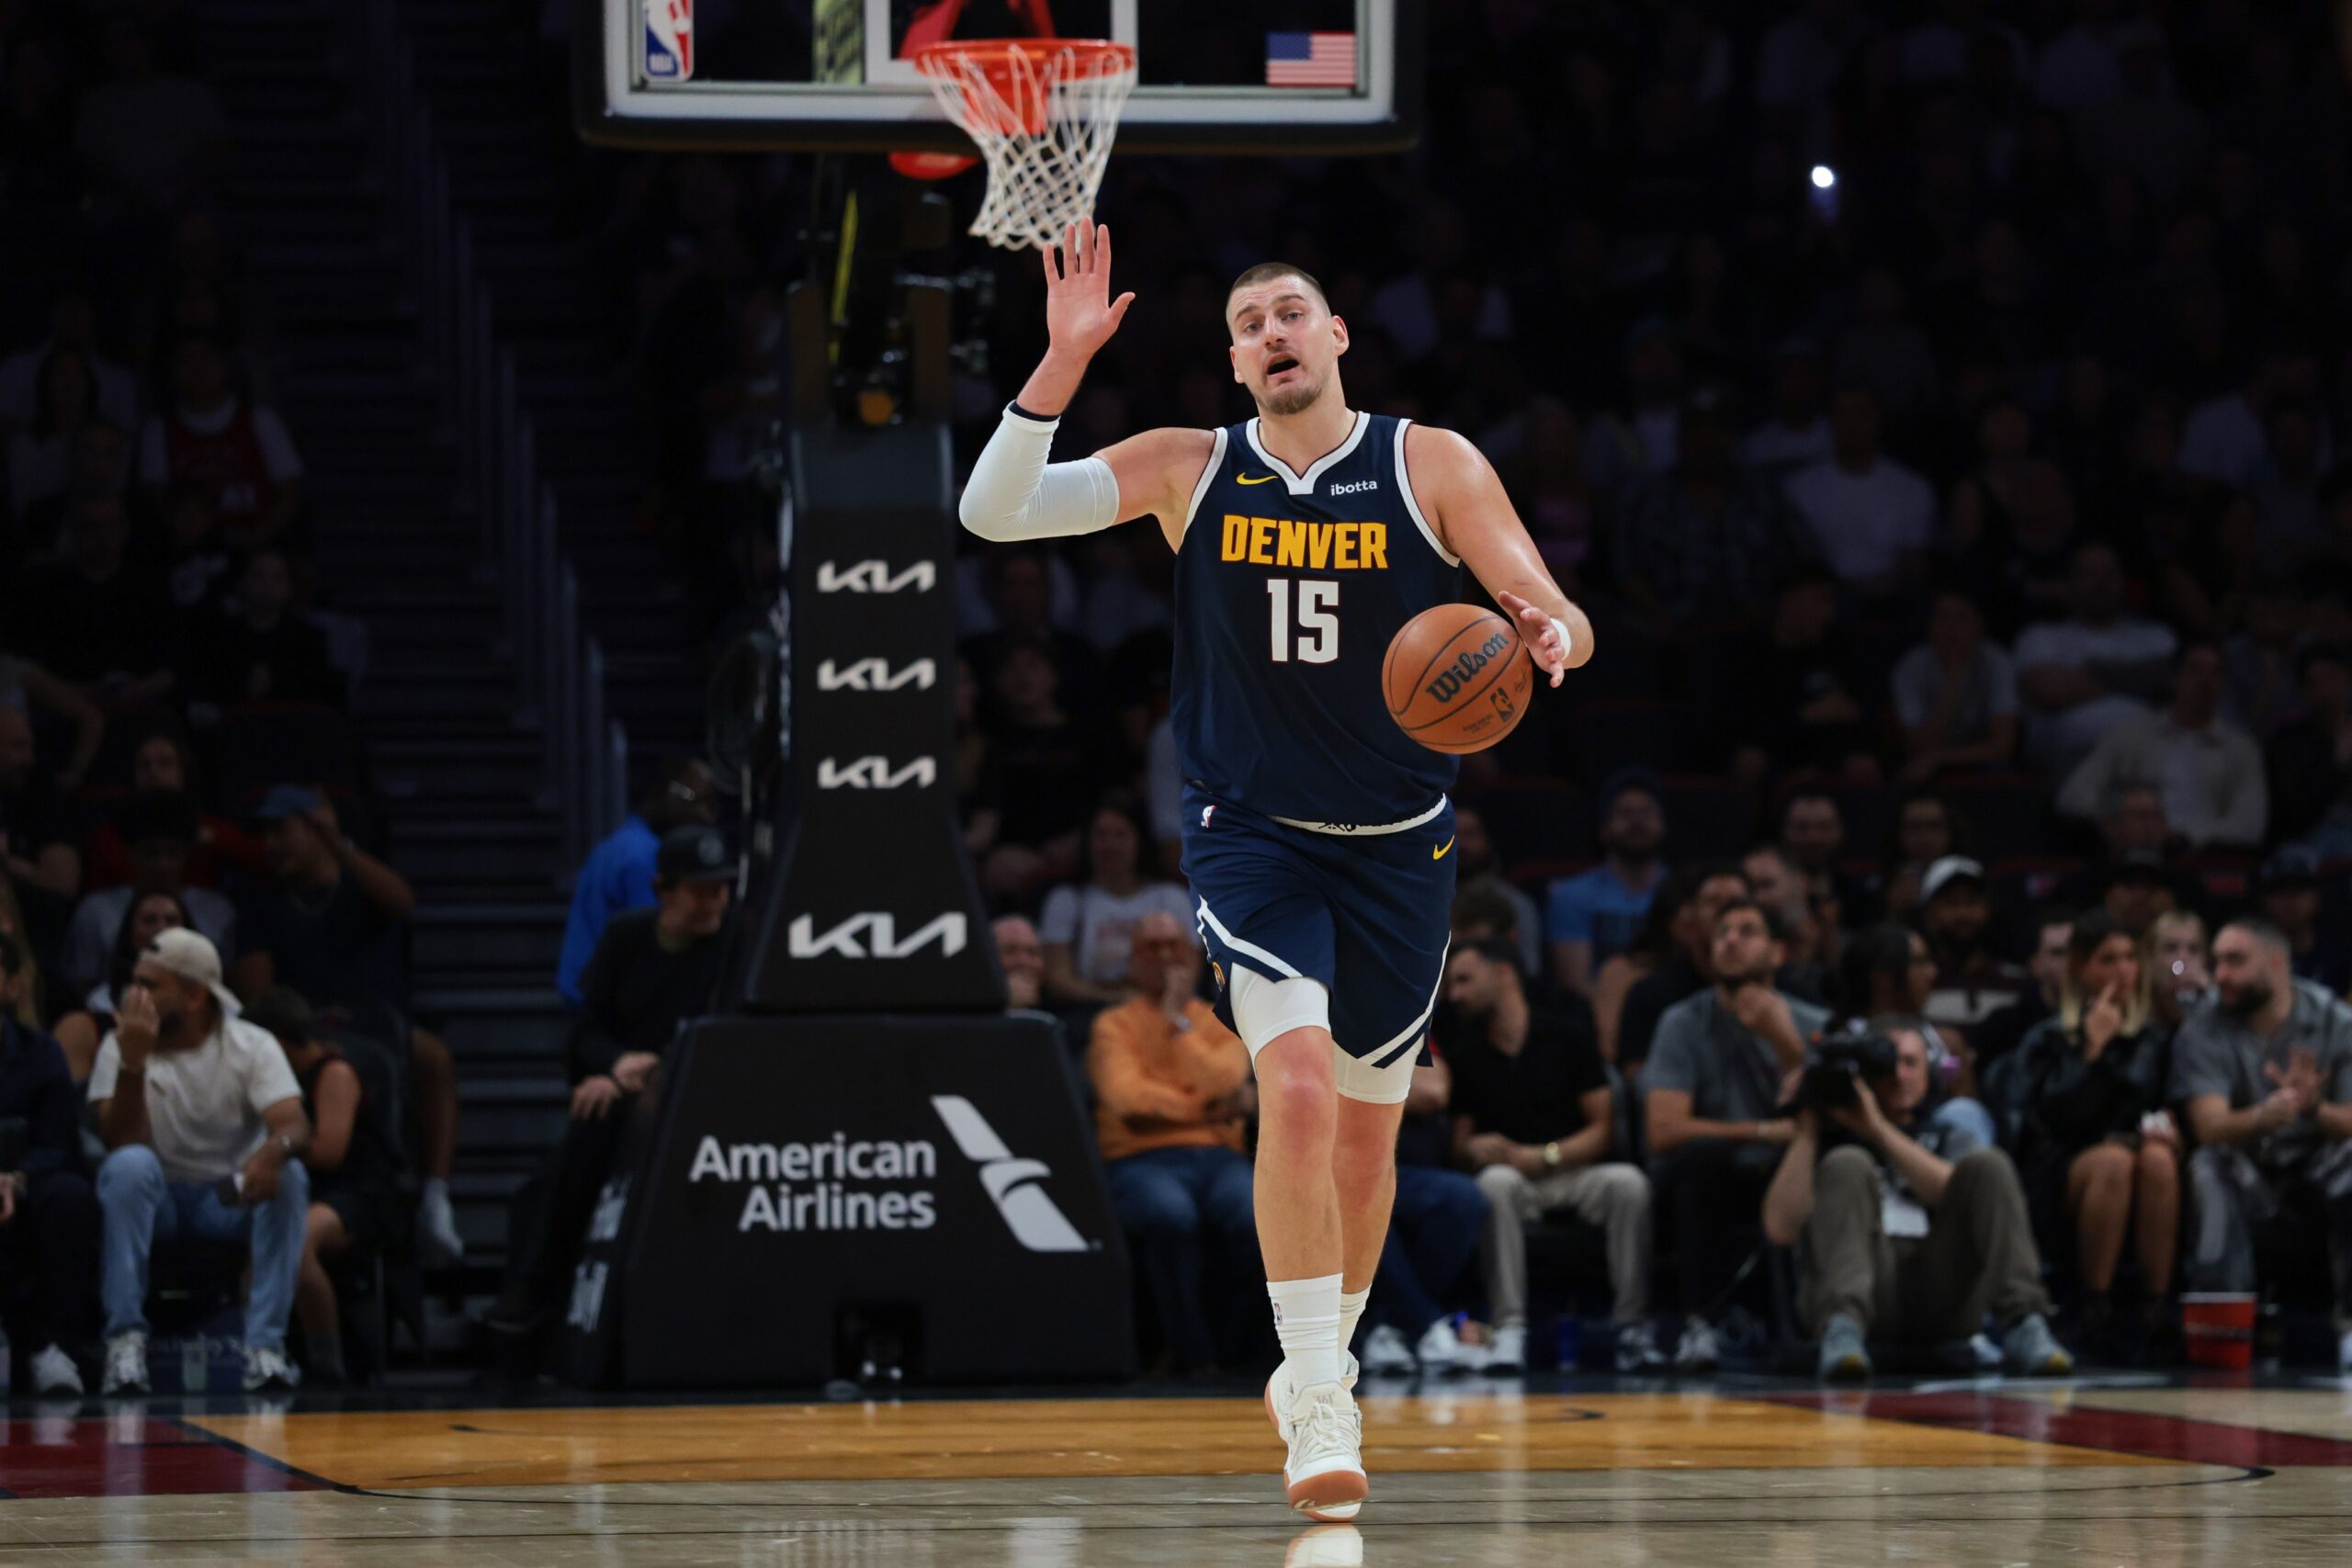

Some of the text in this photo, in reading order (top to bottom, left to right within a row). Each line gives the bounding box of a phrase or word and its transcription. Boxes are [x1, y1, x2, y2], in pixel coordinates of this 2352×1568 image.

[1330, 479, 1378, 496] ibotta
[1221, 514, 1388, 570] DENVER
[817, 560, 936, 592] KIA
[1267, 579, 1340, 664] 15
[817, 658, 936, 691] KIA
[1426, 632, 1509, 703] Wilson
[817, 756, 936, 789] KIA
[788, 912, 967, 958] KIA
[689, 1132, 936, 1181] American
[740, 1183, 936, 1231] Airlines
